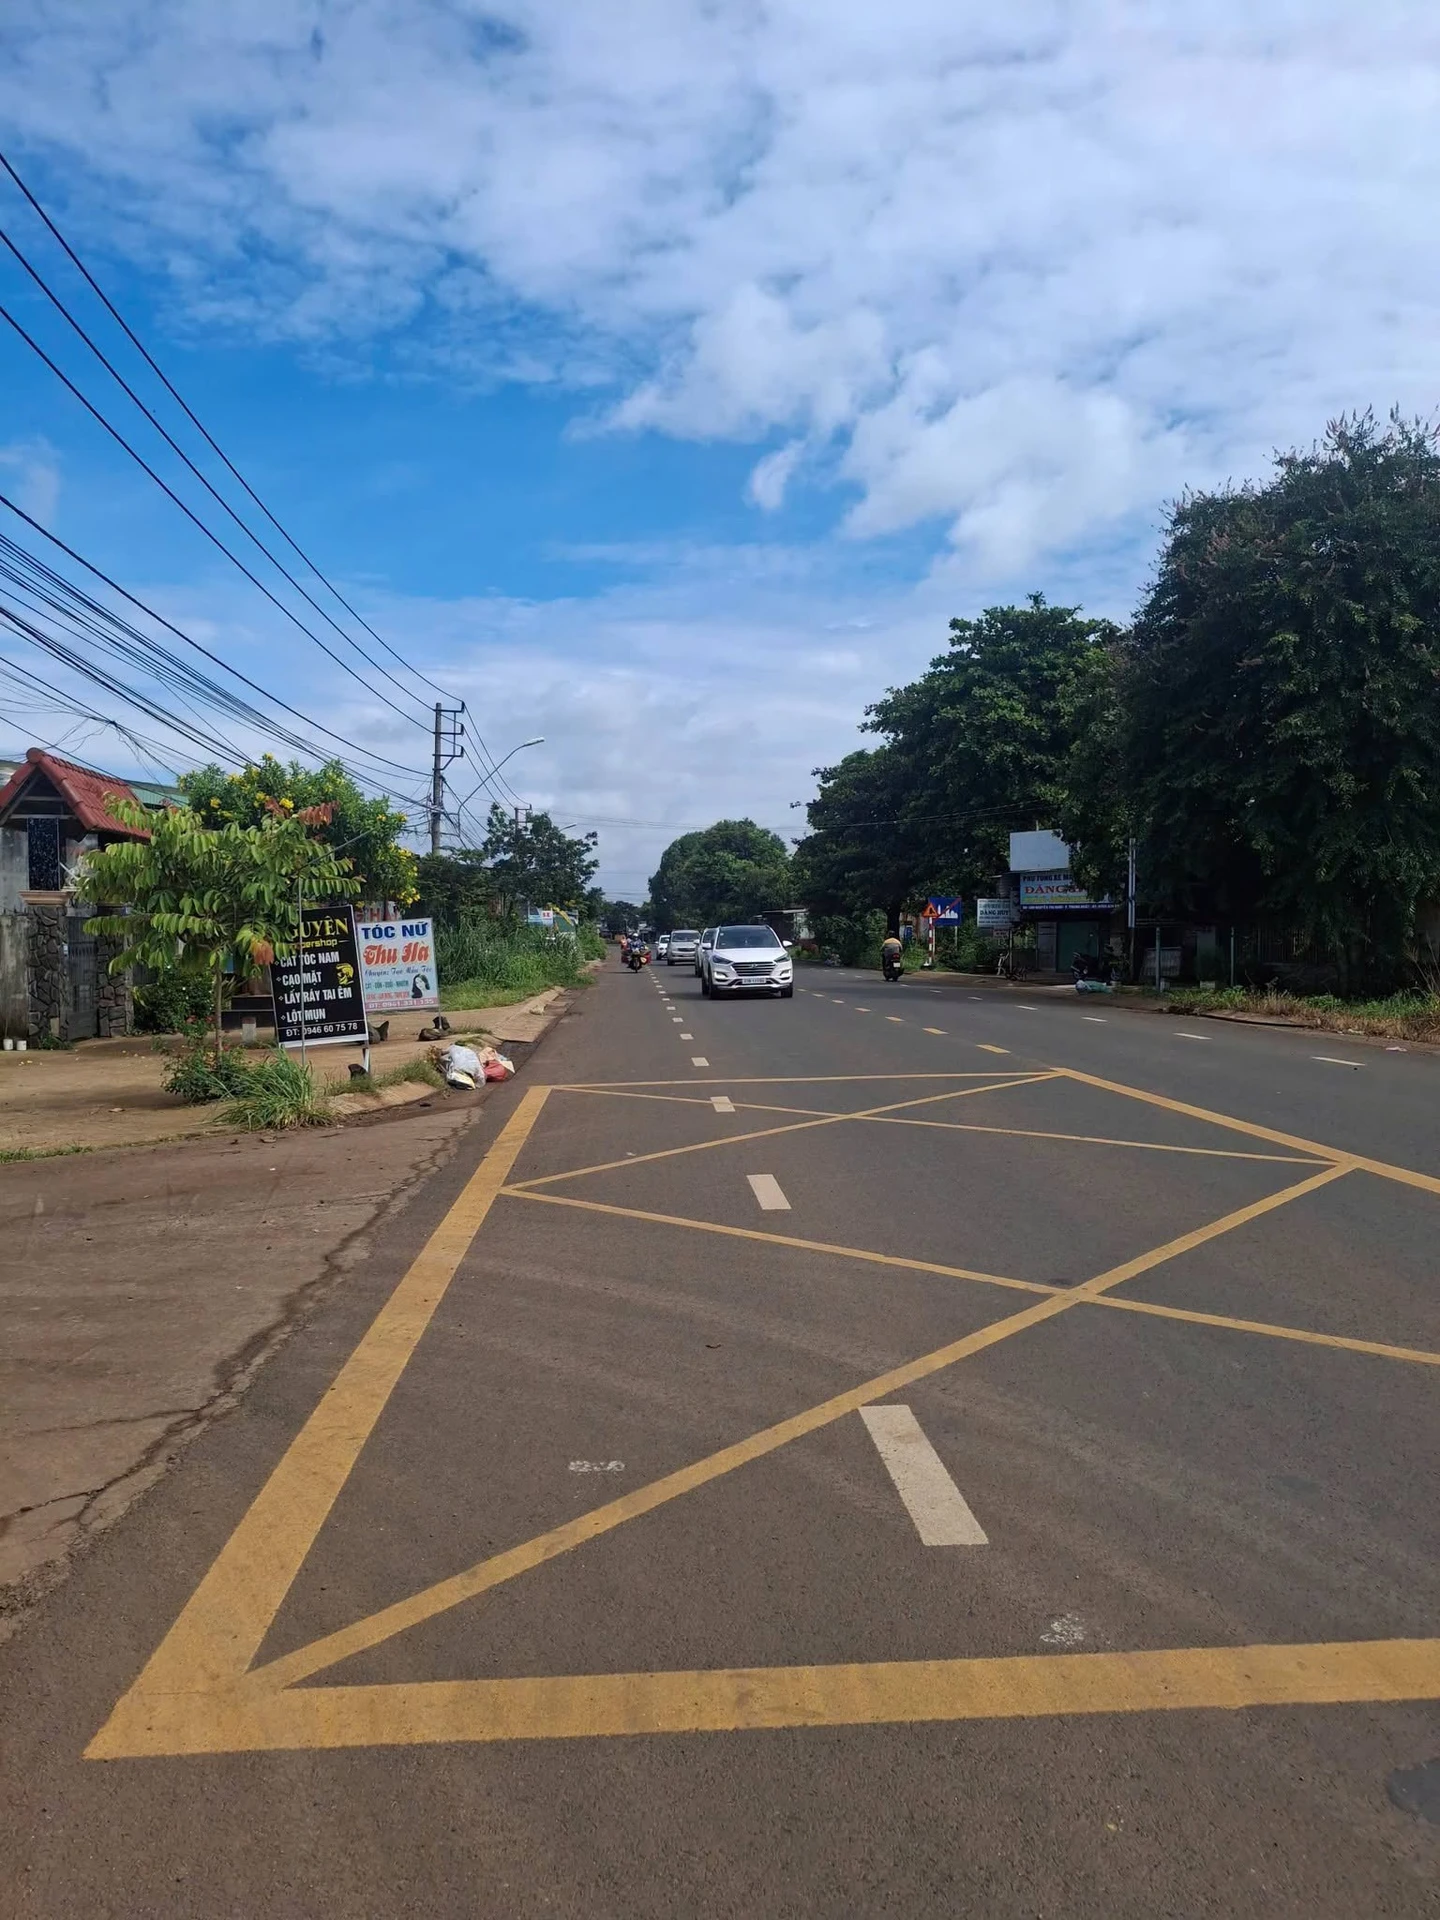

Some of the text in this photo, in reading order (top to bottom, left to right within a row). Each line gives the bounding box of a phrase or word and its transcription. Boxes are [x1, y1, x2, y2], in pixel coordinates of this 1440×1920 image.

[361, 921, 428, 940] TÓC NỮ
[318, 951, 340, 964] NAM
[363, 940, 430, 965] Thu Hà
[281, 970, 322, 988] CẠO MẶT
[284, 989, 301, 1005] LẤY
[303, 988, 320, 1003] RÁY
[322, 989, 336, 1001] TAI
[338, 986, 353, 999] ÊM
[304, 1008, 326, 1022] MỤN
[286, 1022, 358, 1037] ĐT: 0946 60 75 78
